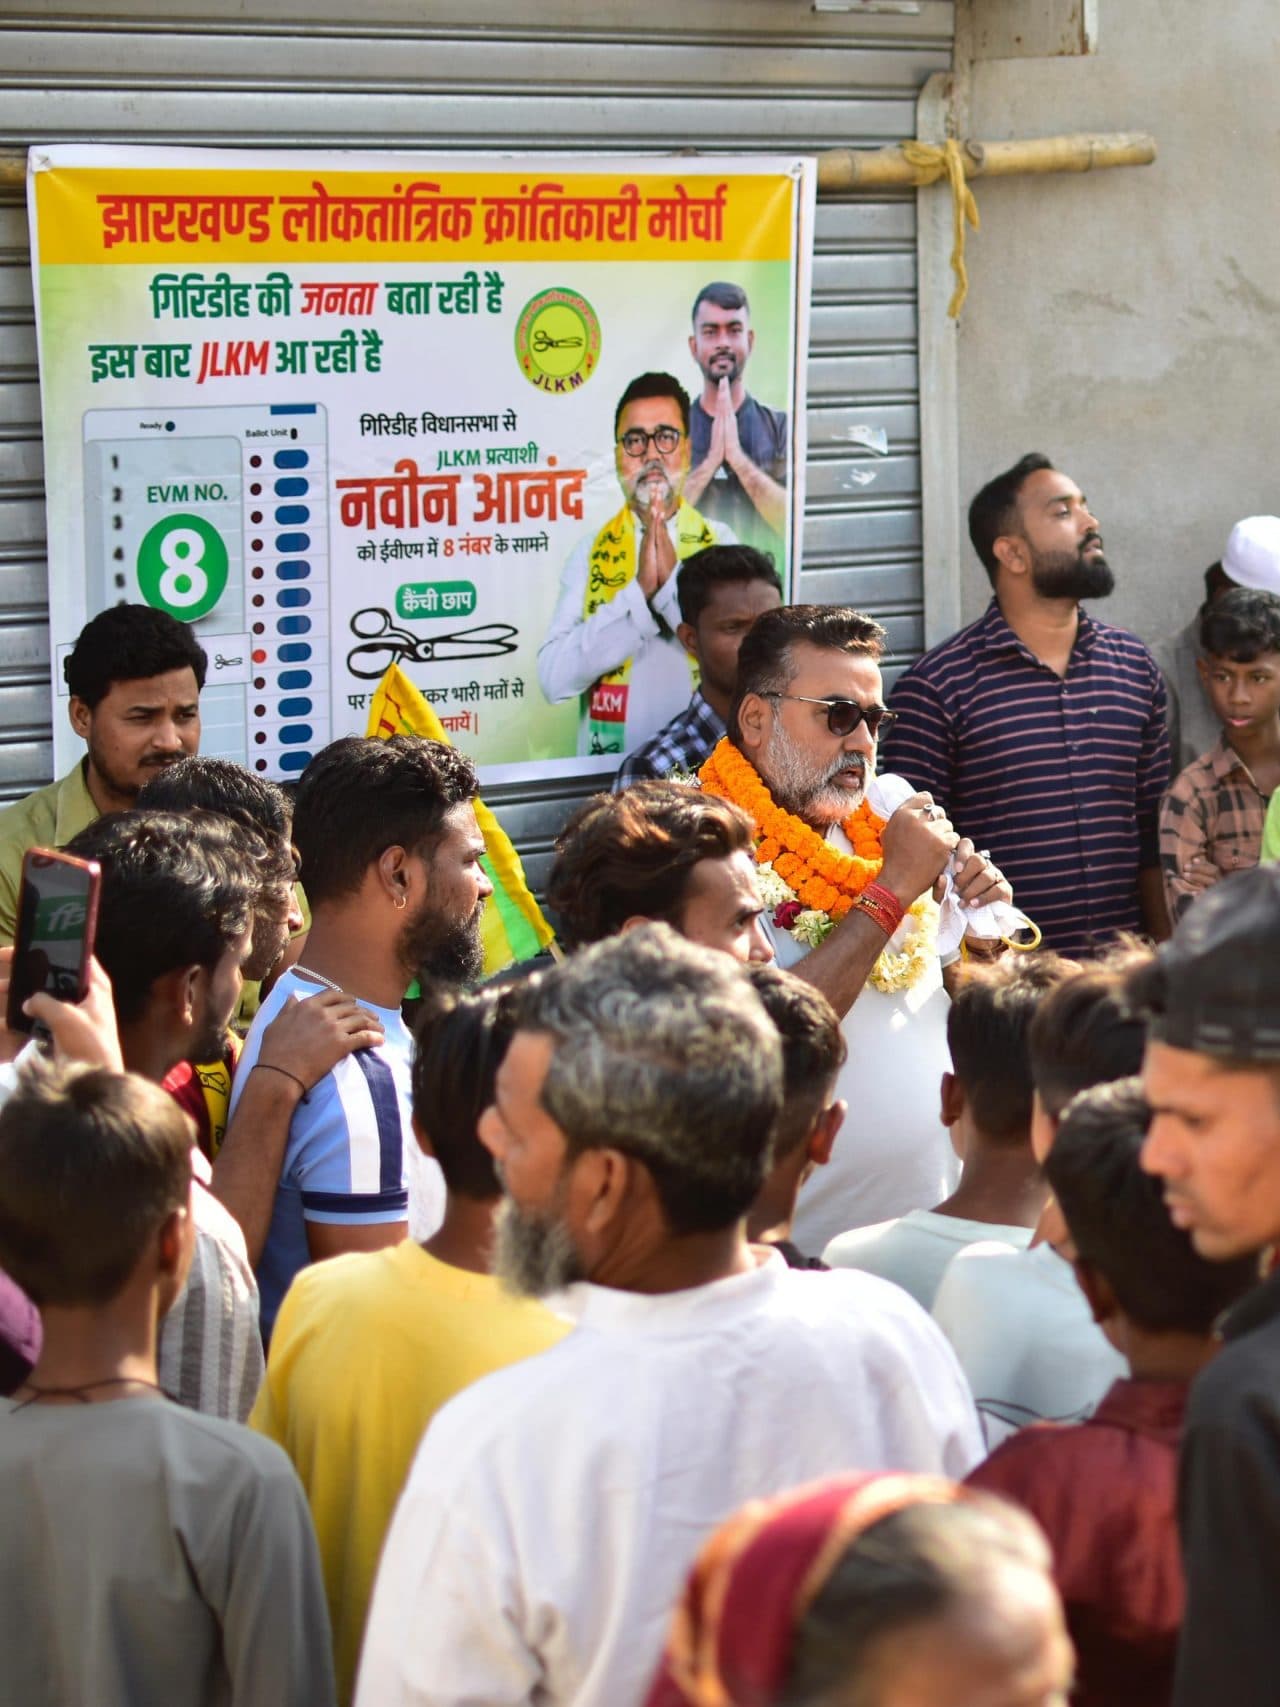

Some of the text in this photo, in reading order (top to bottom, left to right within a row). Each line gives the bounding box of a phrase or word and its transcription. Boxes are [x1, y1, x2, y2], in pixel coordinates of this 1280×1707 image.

[96, 181, 727, 248] झारखण्ड लोकतांत्रिक क्रांतिकारी मोर्चा
[149, 271, 504, 318] गिरिडीह की जनता बता रही है
[88, 329, 383, 384] इस बार JLKM आ रही है
[533, 372, 584, 392] JLKM
[246, 428, 287, 438] Ballot Unit
[360, 409, 517, 437] गिरिडीह विधानसभा से
[437, 441, 539, 471] JLKM प्रत्याशी
[147, 483, 228, 503] EVM NO.
[336, 455, 588, 530] नवीन आनंद
[357, 531, 548, 563] को ईवीएम में 8 नंबर के सामने
[159, 528, 208, 608] 8
[402, 588, 472, 612] कैंची छाप
[348, 693, 365, 710] पर
[451, 680, 480, 702] भारी
[483, 679, 508, 700] मतों
[511, 677, 524, 698] से
